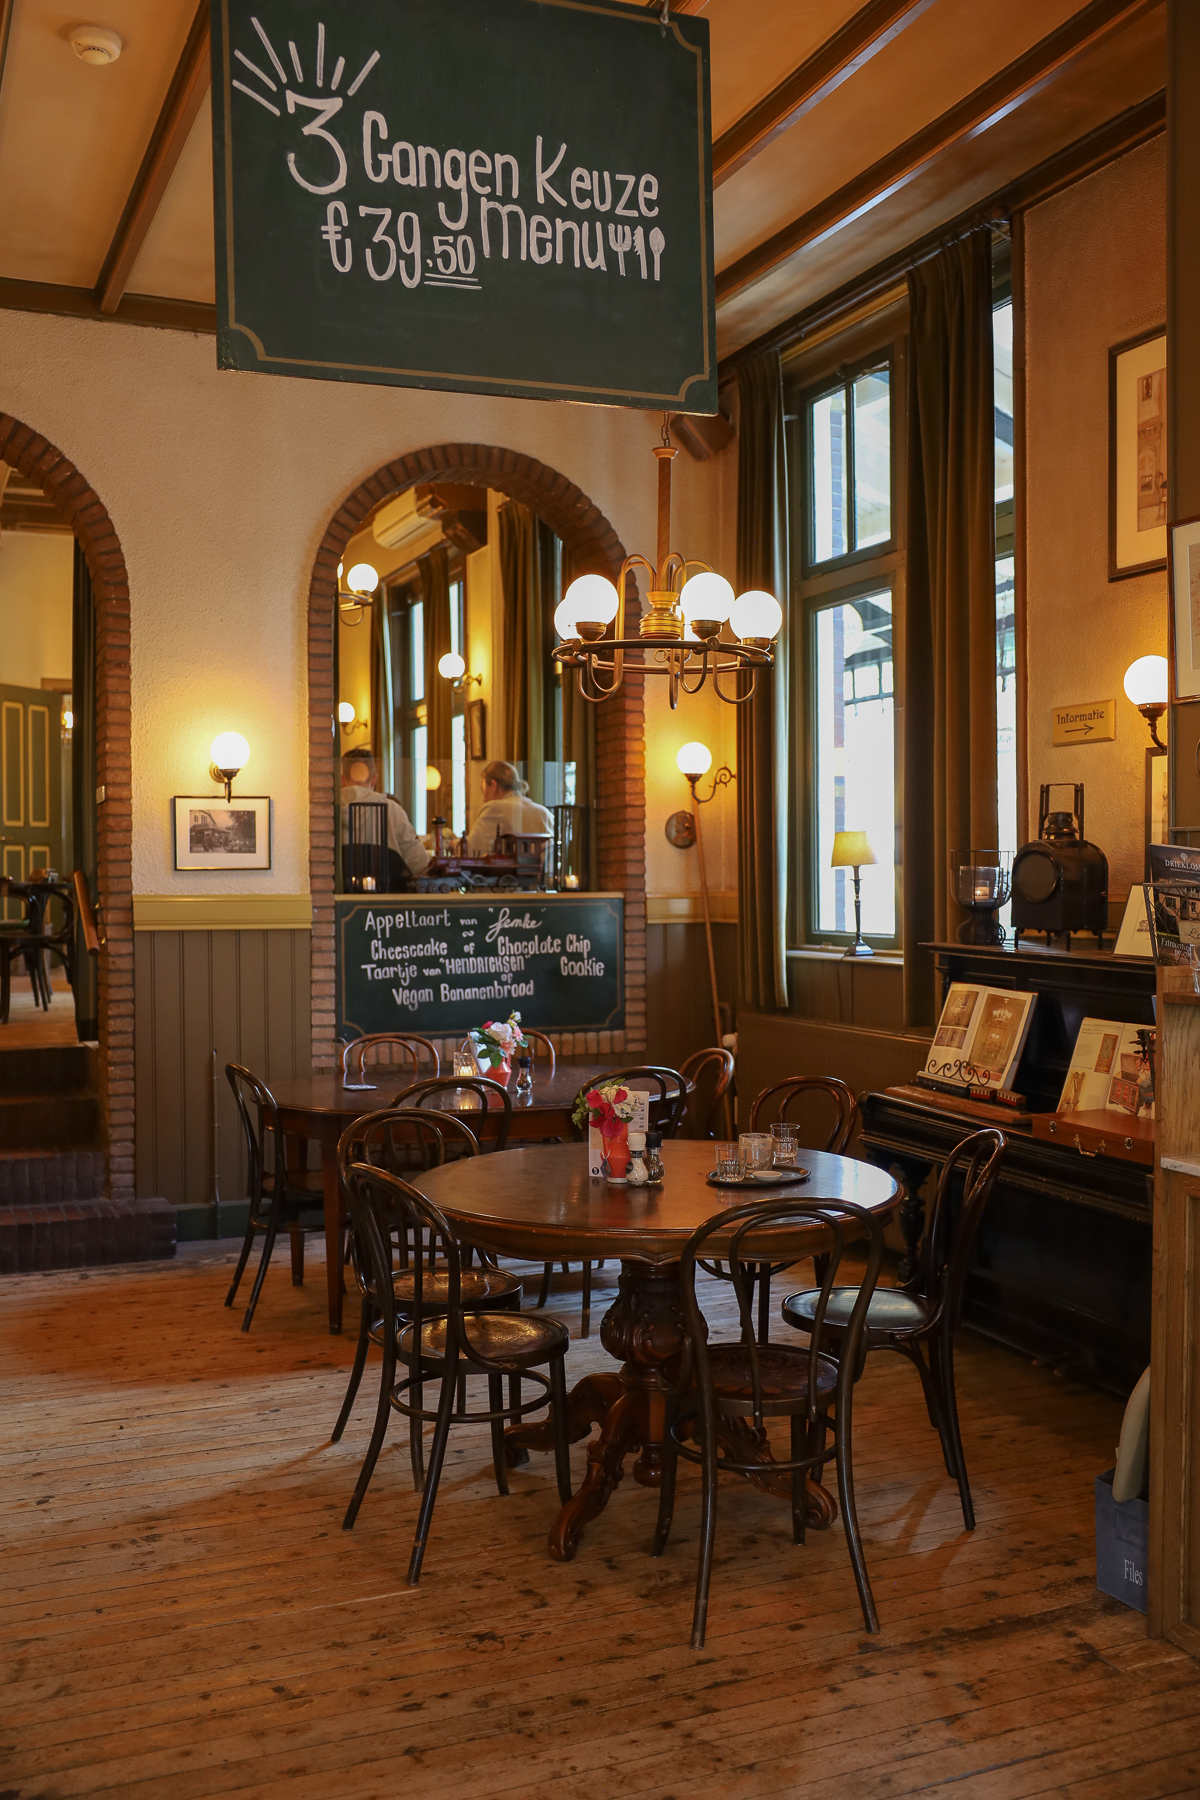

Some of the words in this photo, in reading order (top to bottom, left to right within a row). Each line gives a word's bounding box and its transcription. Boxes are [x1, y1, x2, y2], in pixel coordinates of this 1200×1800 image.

[286, 90, 347, 195] 3
[363, 110, 518, 231] Gangen
[536, 135, 660, 218] Keuze
[1057, 709, 1105, 725] Informatie
[364, 909, 451, 938] Appeltaart
[460, 917, 478, 926] van
[370, 938, 448, 961] Cheesecake
[463, 941, 476, 955] of
[497, 935, 561, 957] Chocolate
[566, 933, 592, 958] Chip
[361, 964, 417, 986] Taartje
[423, 966, 442, 977] van
[501, 973, 513, 984] of
[560, 956, 605, 977] Cookie
[392, 986, 434, 1011] Vegan
[440, 980, 534, 1003] Bananenbrood
[1124, 1558, 1143, 1586] Files
